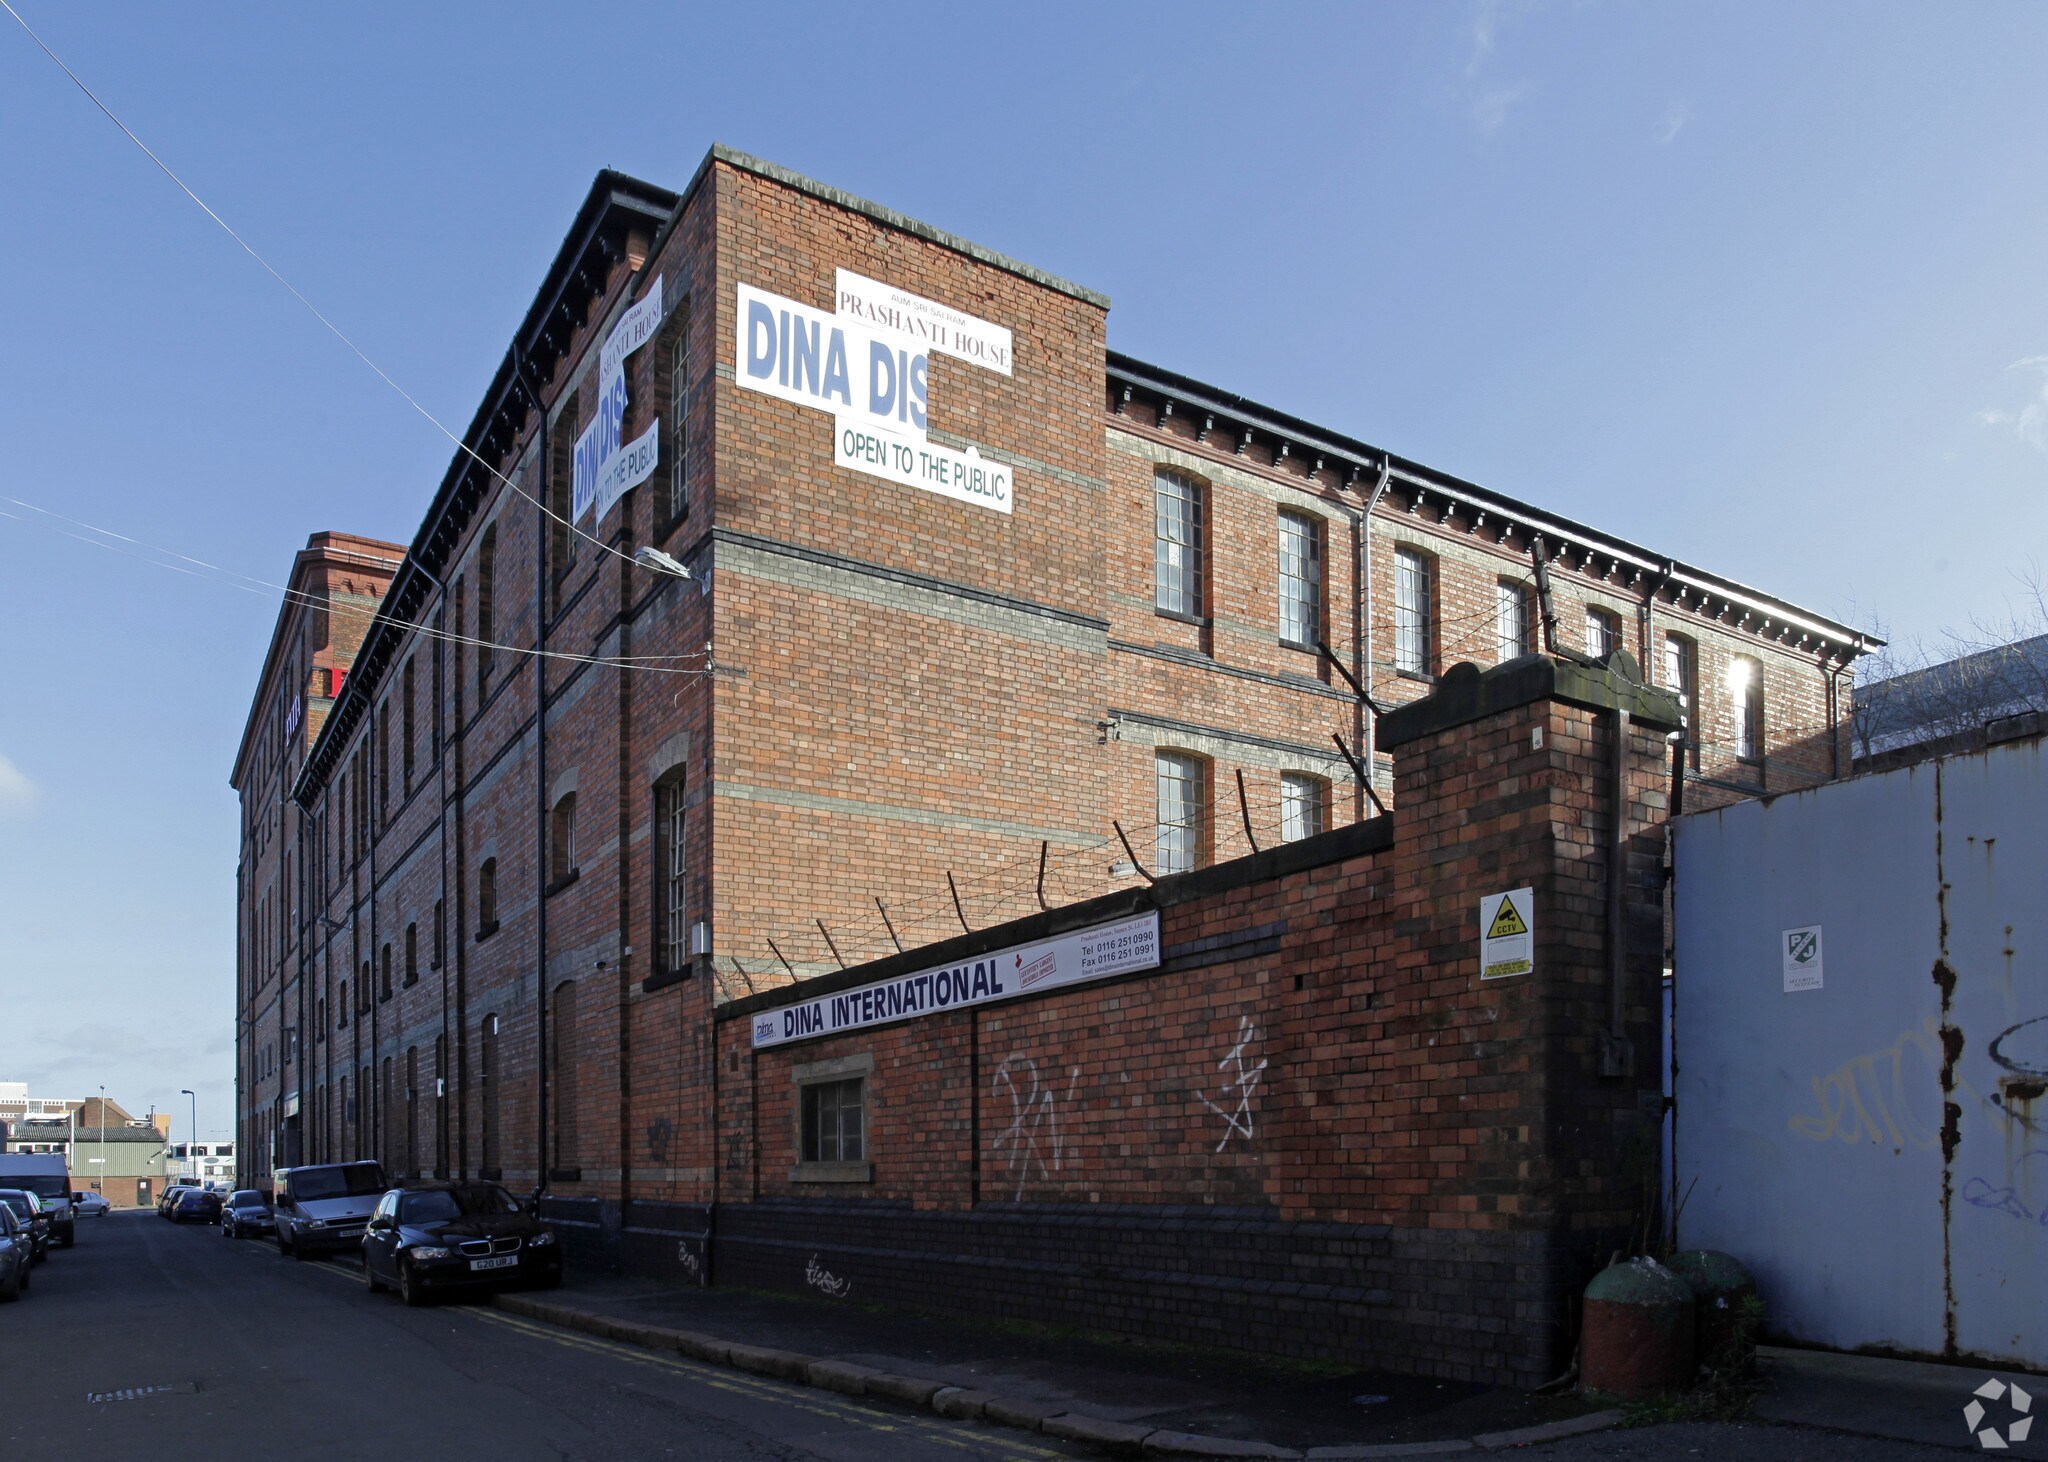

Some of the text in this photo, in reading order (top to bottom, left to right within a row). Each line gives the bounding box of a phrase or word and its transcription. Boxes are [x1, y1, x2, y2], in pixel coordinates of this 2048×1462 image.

[629, 307, 642, 322] RAM
[634, 297, 661, 343] HOUSE
[891, 294, 966, 327] AUM SRI SAI RAM
[840, 291, 1010, 369] PRASHANTI HOUSE
[747, 299, 928, 431] DINA DIS
[576, 374, 627, 513] DIN DIS
[604, 475, 612, 502] TO
[613, 458, 626, 490] THE
[628, 433, 656, 479] PUBLIC
[843, 429, 1006, 501] OPEN TO THE PUBLIC
[1082, 931, 1154, 956] Tel 0116 251 0990
[1497, 924, 1517, 934] CCTV
[1791, 934, 1802, 947] P
[1082, 943, 1154, 968] Fax 0116 251 0991
[1803, 945, 1814, 958] J
[784, 960, 1003, 1038] DINA INTERNATIONAL
[476, 1257, 513, 1269] G20 URJ
